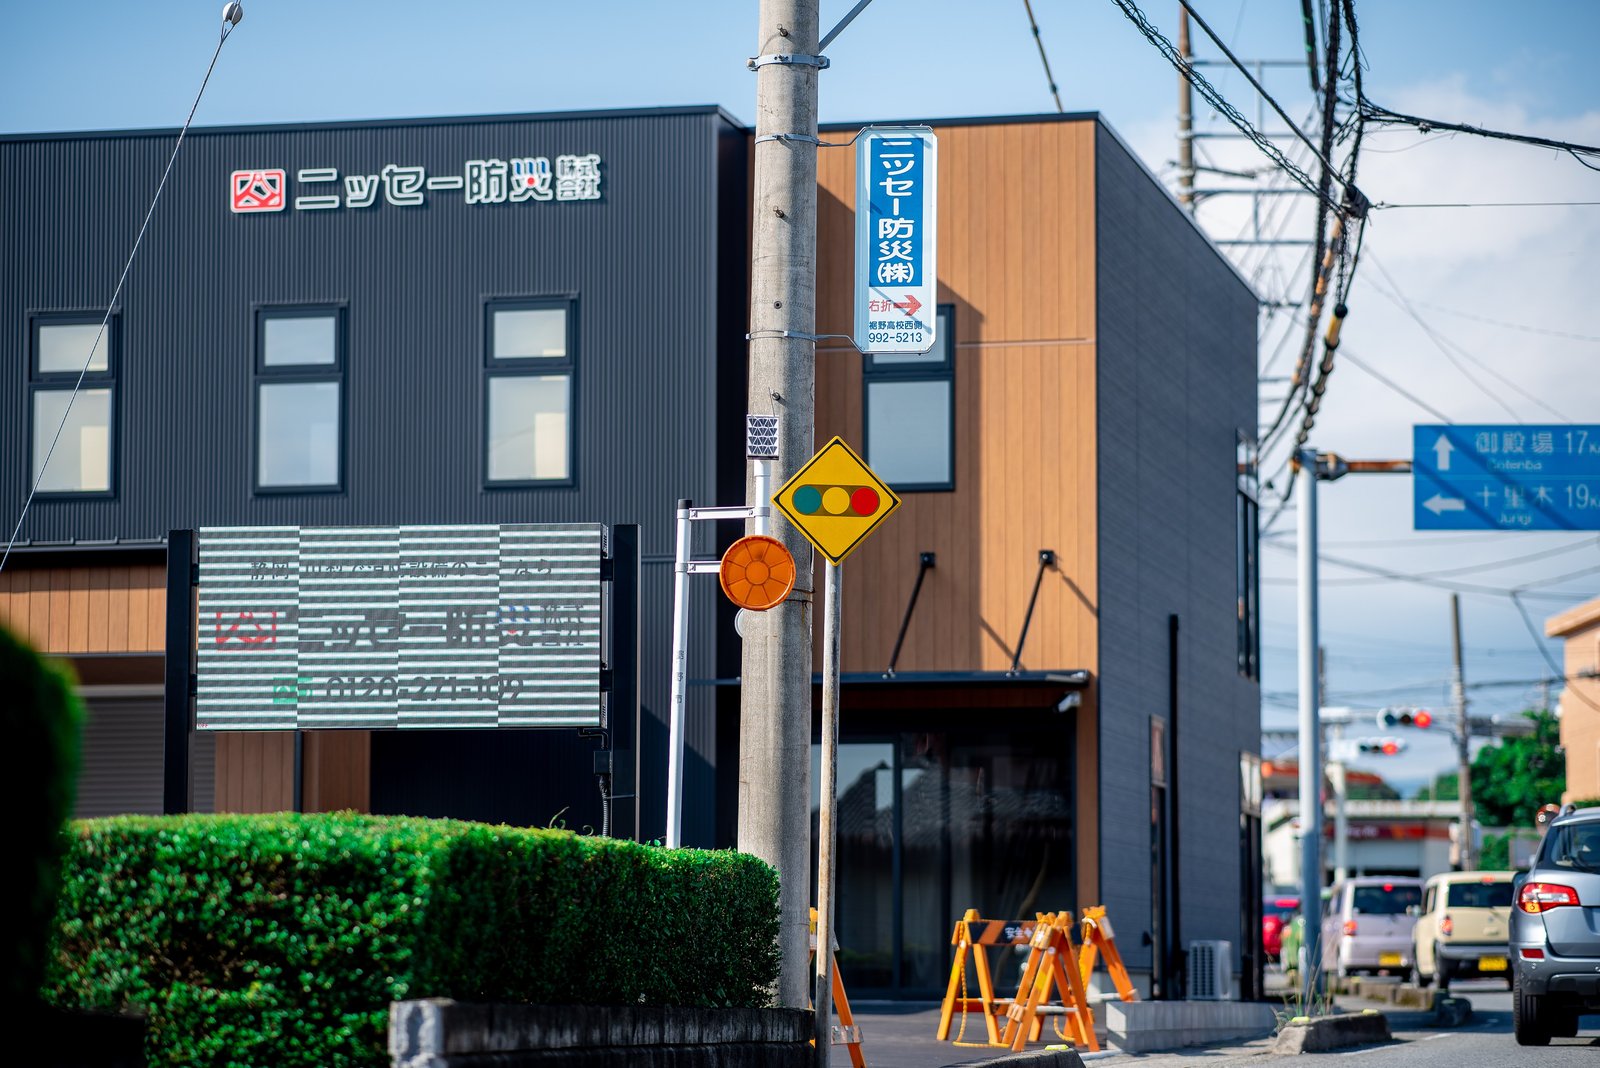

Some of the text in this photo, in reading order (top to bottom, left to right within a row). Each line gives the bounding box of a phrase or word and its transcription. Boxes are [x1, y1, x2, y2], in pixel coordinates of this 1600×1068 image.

[877, 140, 915, 284] ニッセー防災(株)
[868, 299, 892, 313] 右折
[868, 331, 923, 343] 992-5213
[1475, 431, 1554, 453] 御殿場
